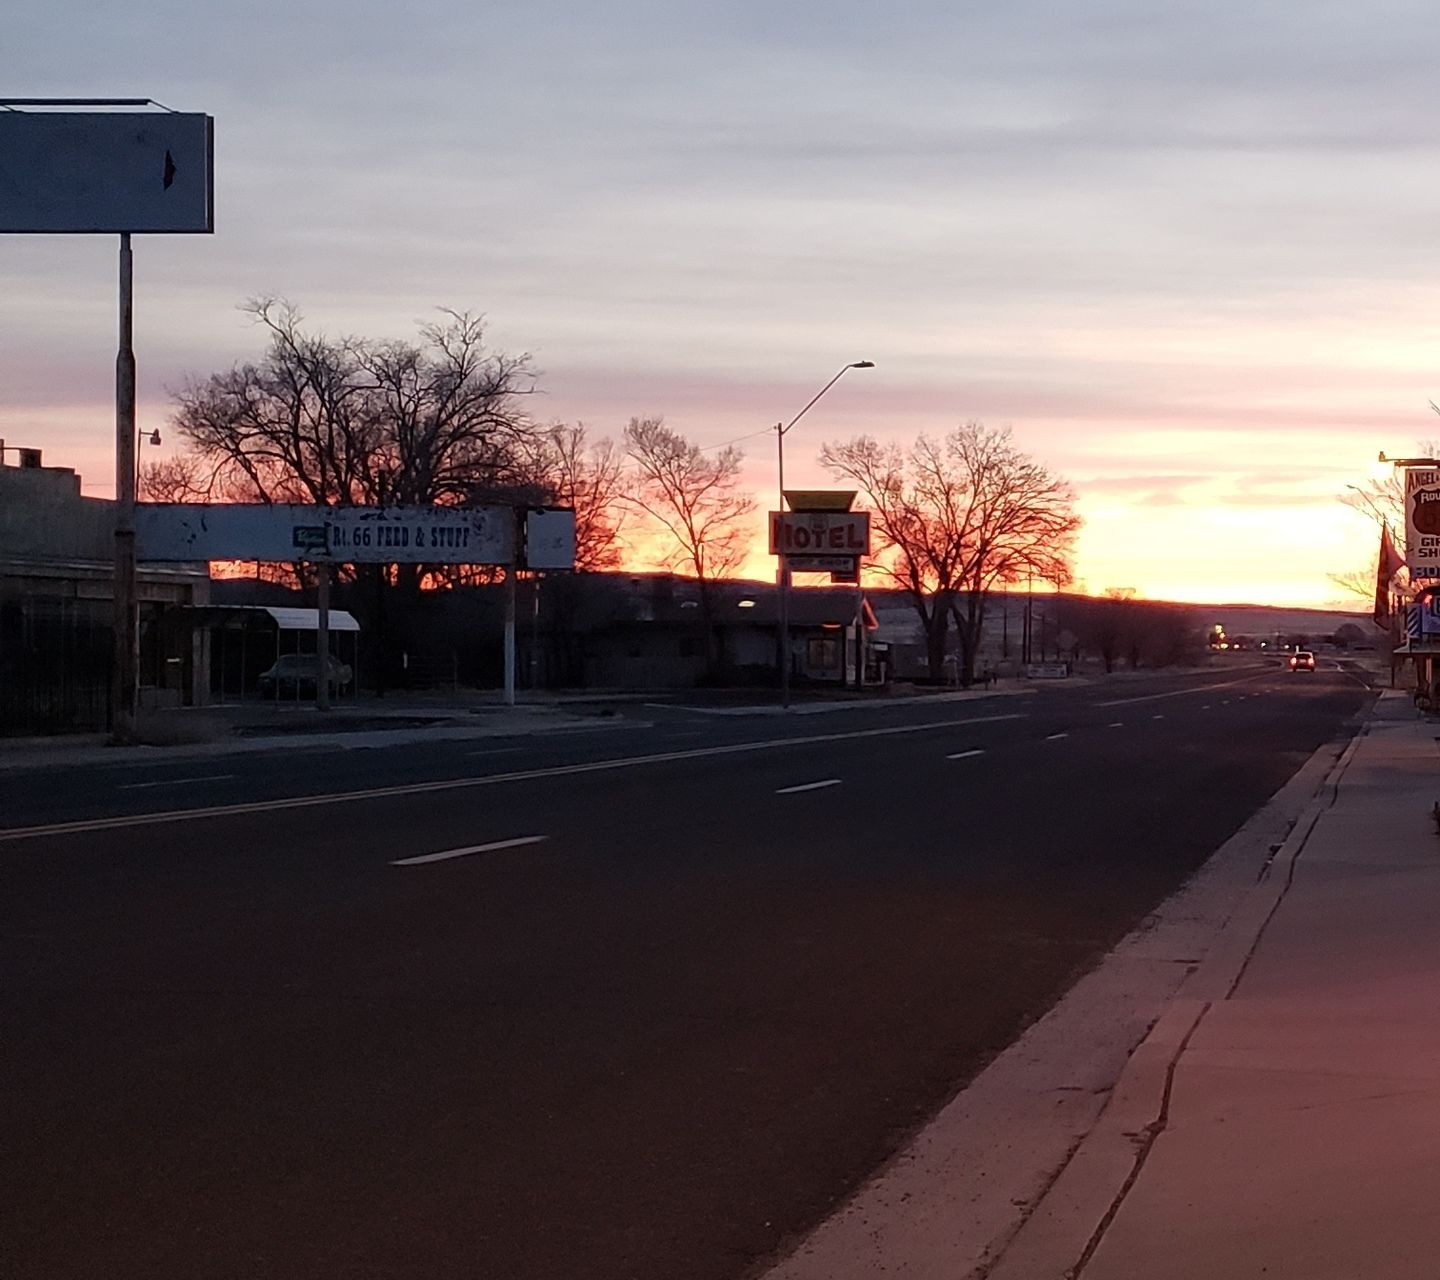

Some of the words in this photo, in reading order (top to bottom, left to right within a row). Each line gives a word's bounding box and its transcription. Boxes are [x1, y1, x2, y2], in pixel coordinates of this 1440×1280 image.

[353, 526, 371, 546] 66
[377, 526, 409, 547] FEED
[415, 527, 425, 547] &
[431, 526, 470, 547] STUFF
